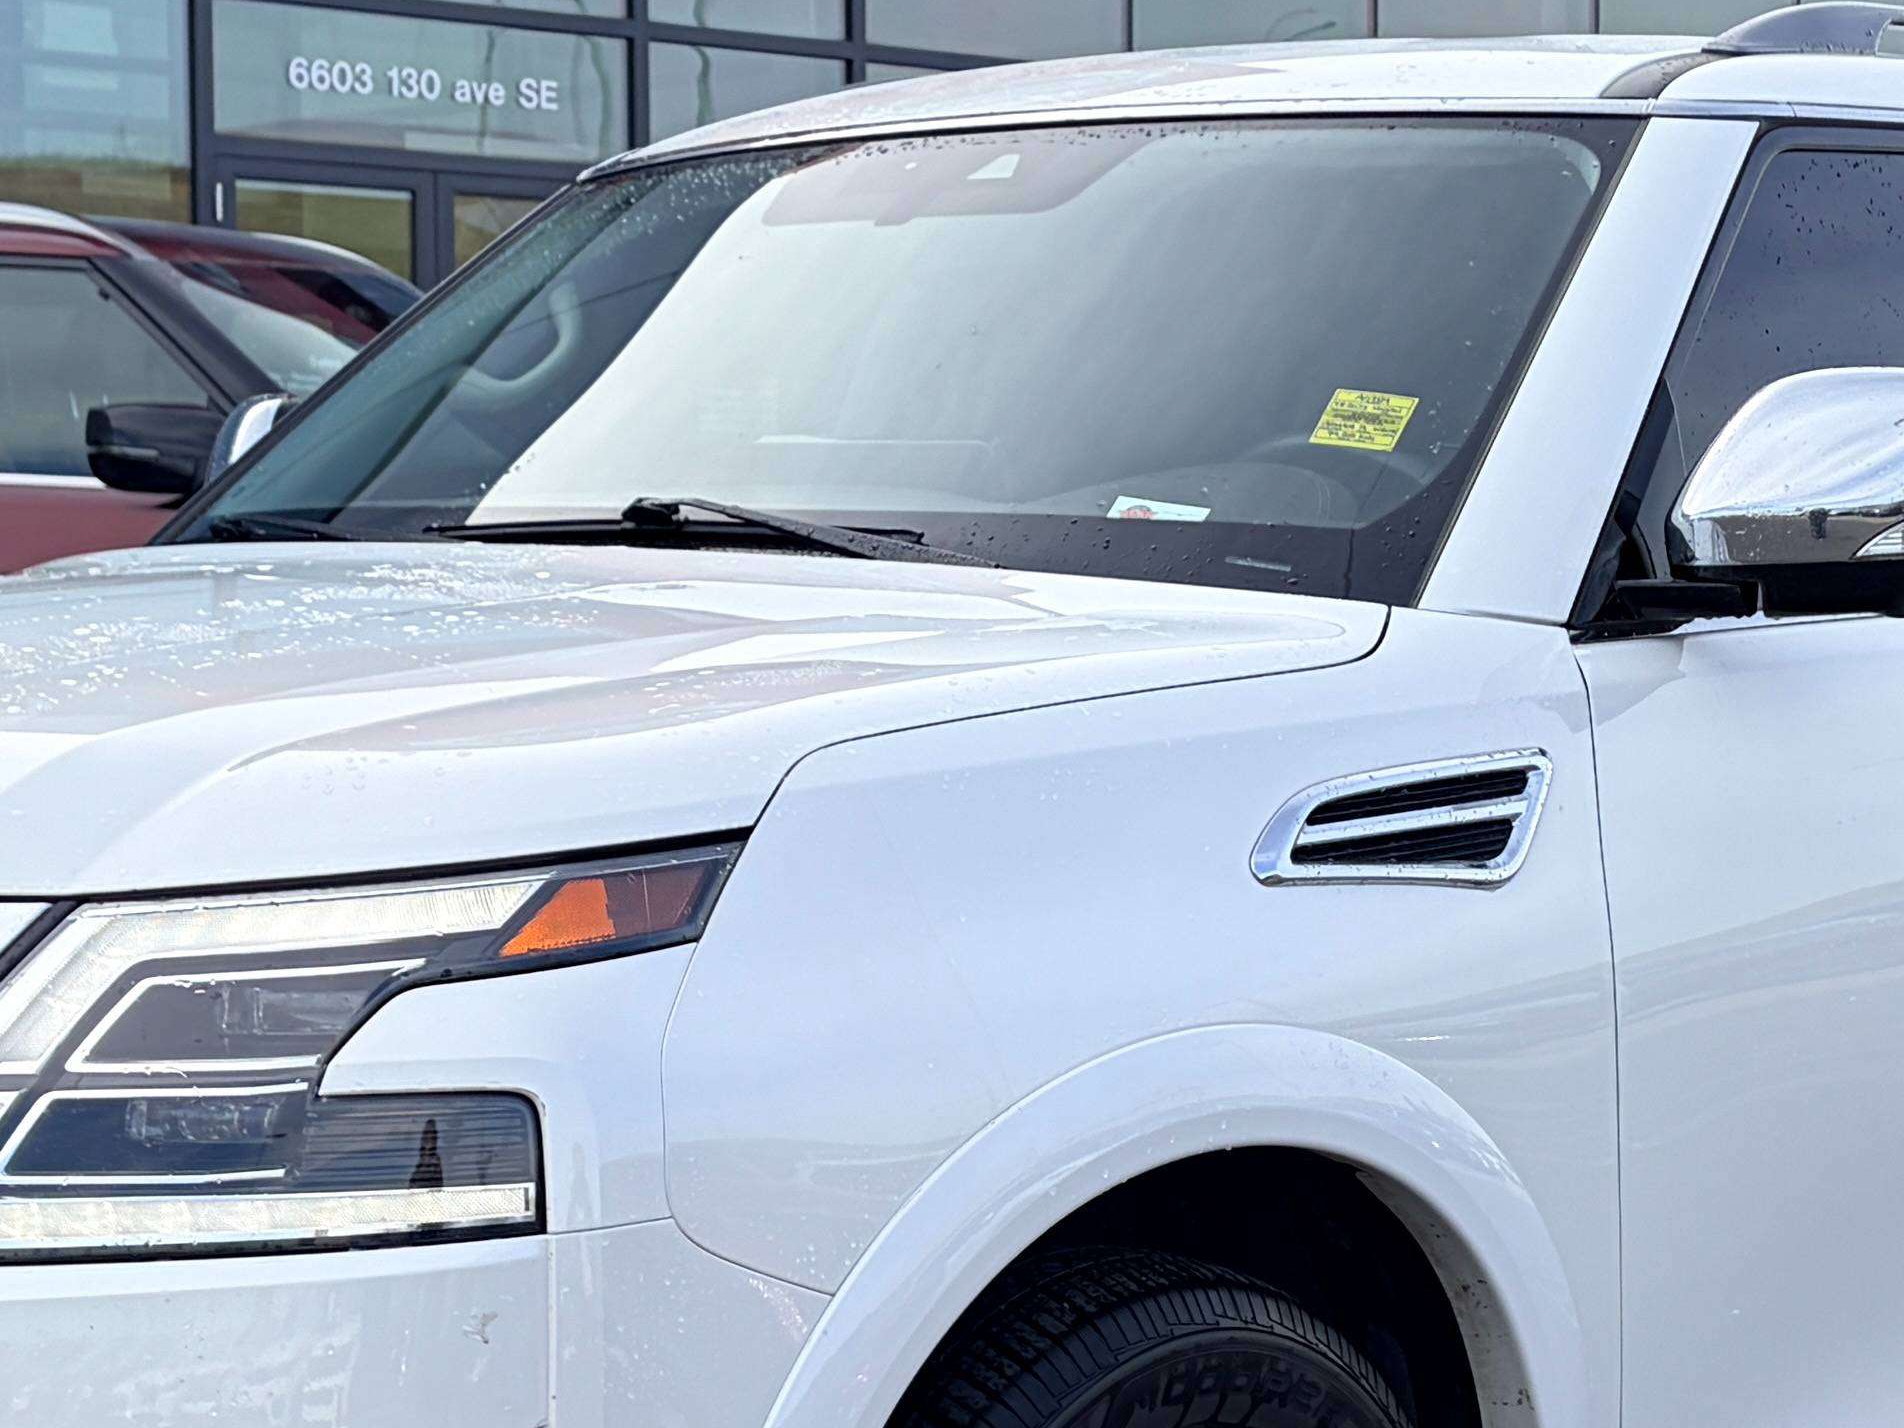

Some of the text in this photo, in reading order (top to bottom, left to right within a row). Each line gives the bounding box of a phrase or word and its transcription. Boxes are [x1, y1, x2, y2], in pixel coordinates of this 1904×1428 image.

[289, 56, 559, 111] 6603 130 ave SE
